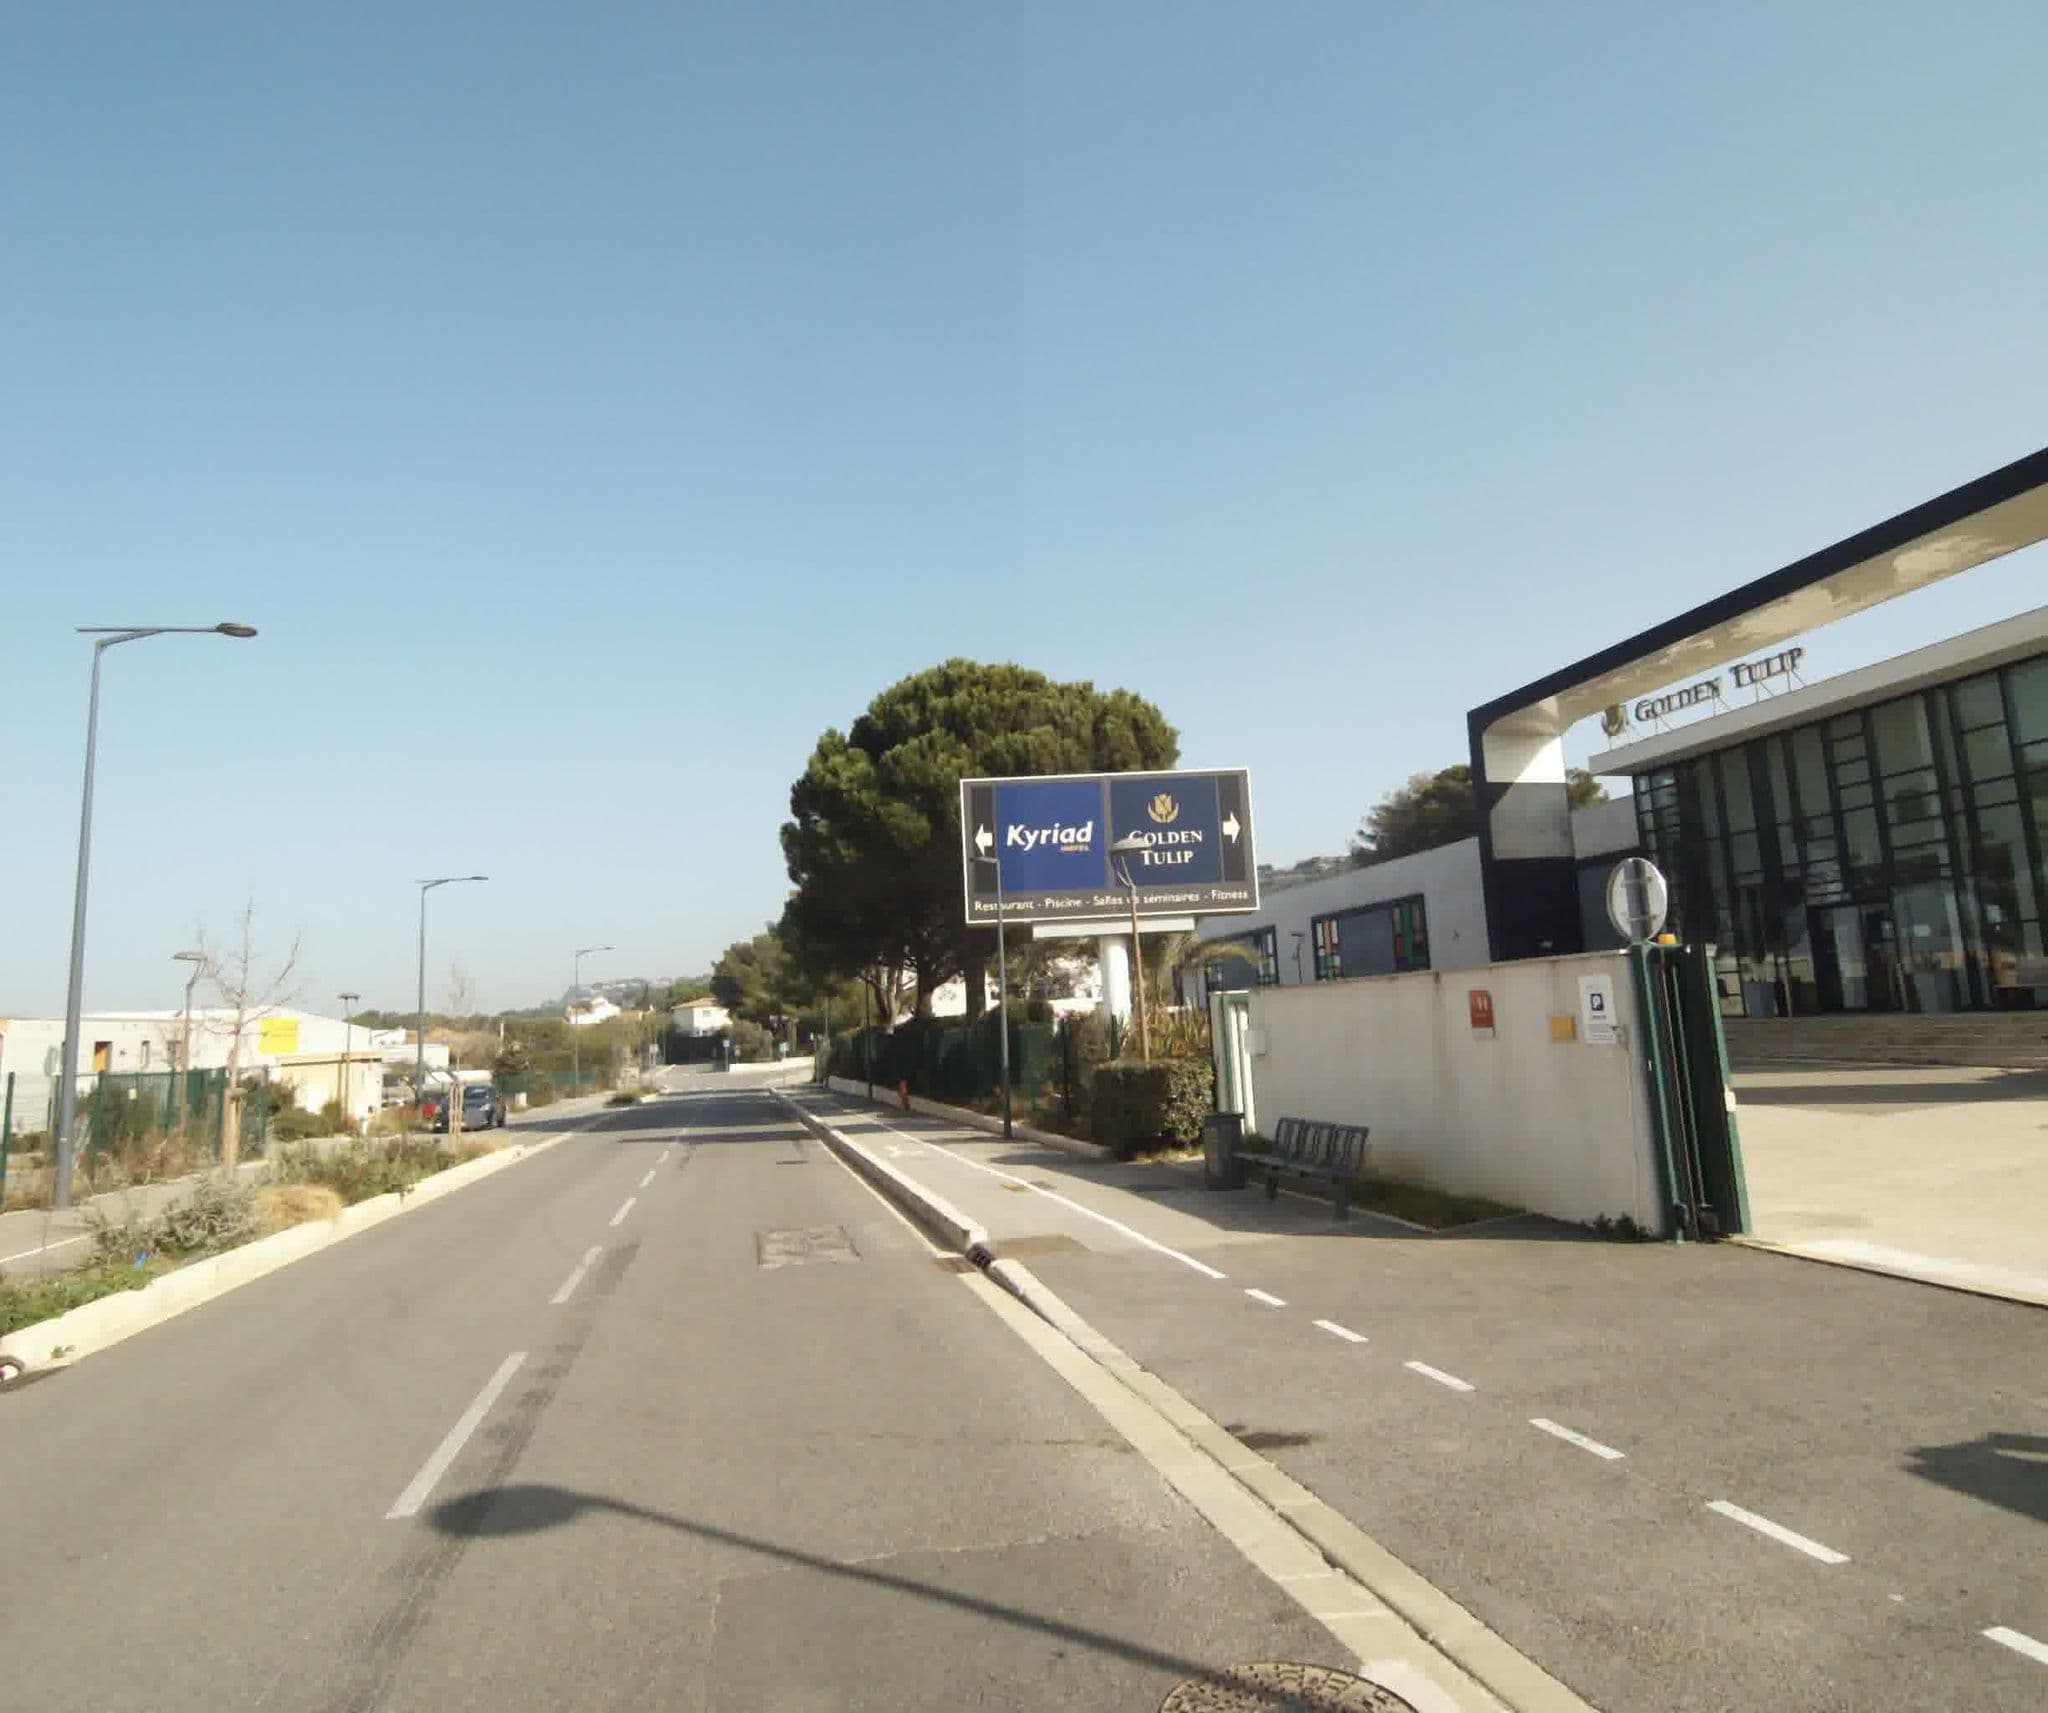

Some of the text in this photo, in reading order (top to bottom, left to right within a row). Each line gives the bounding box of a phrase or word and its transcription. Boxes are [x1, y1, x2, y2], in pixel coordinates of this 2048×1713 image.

[1634, 647, 1805, 722] GOLDEN TULIP
[1006, 820, 1094, 851] Kyriad
[1140, 850, 1194, 866] TULIP
[1044, 897, 1082, 909] Piscine
[1093, 895, 1123, 906] Salles
[1211, 889, 1249, 901] Fitness
